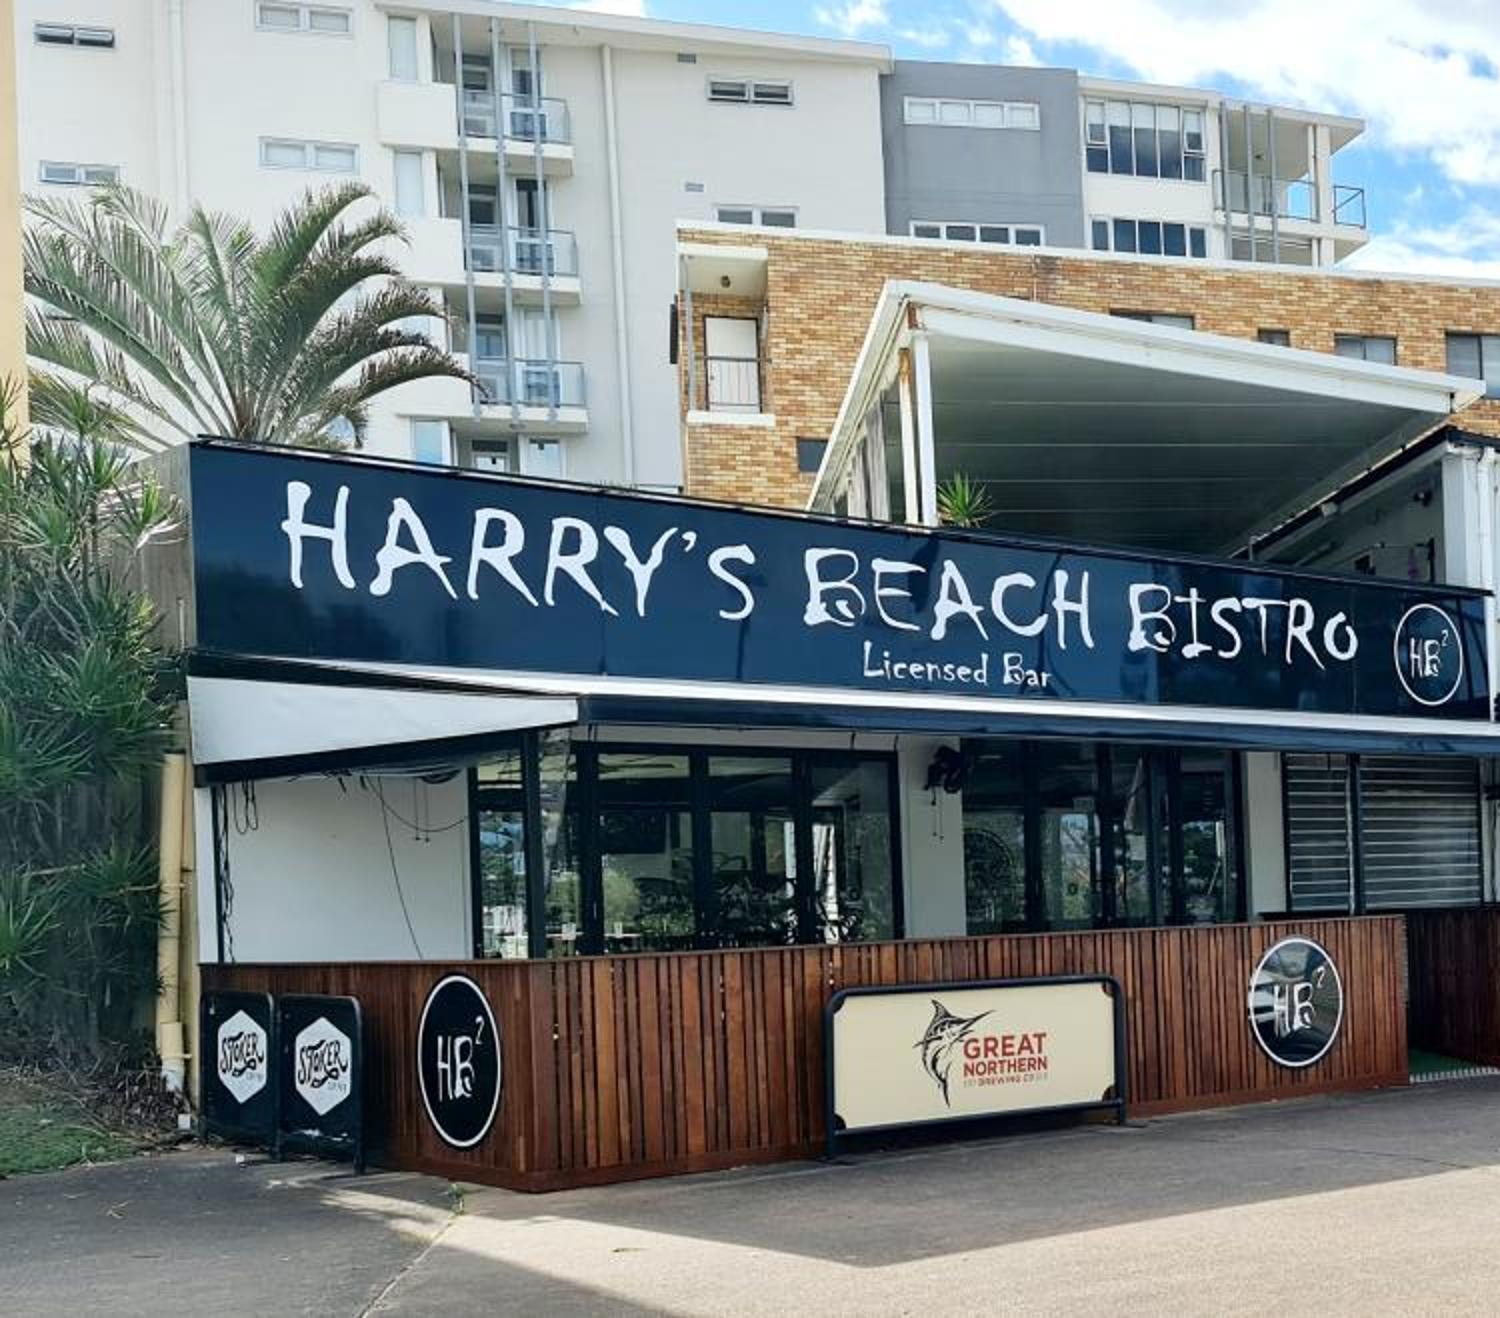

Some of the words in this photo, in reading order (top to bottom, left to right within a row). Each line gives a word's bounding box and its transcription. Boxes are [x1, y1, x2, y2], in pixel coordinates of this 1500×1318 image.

[279, 480, 755, 622] HARRY'S
[803, 546, 1095, 651] BEACH
[1127, 582, 1359, 670] BISTRO
[863, 640, 989, 686] Licensed
[1003, 652, 1052, 687] Bar
[963, 1032, 1047, 1060] GREAT
[963, 1055, 1048, 1077] NORTHERN
